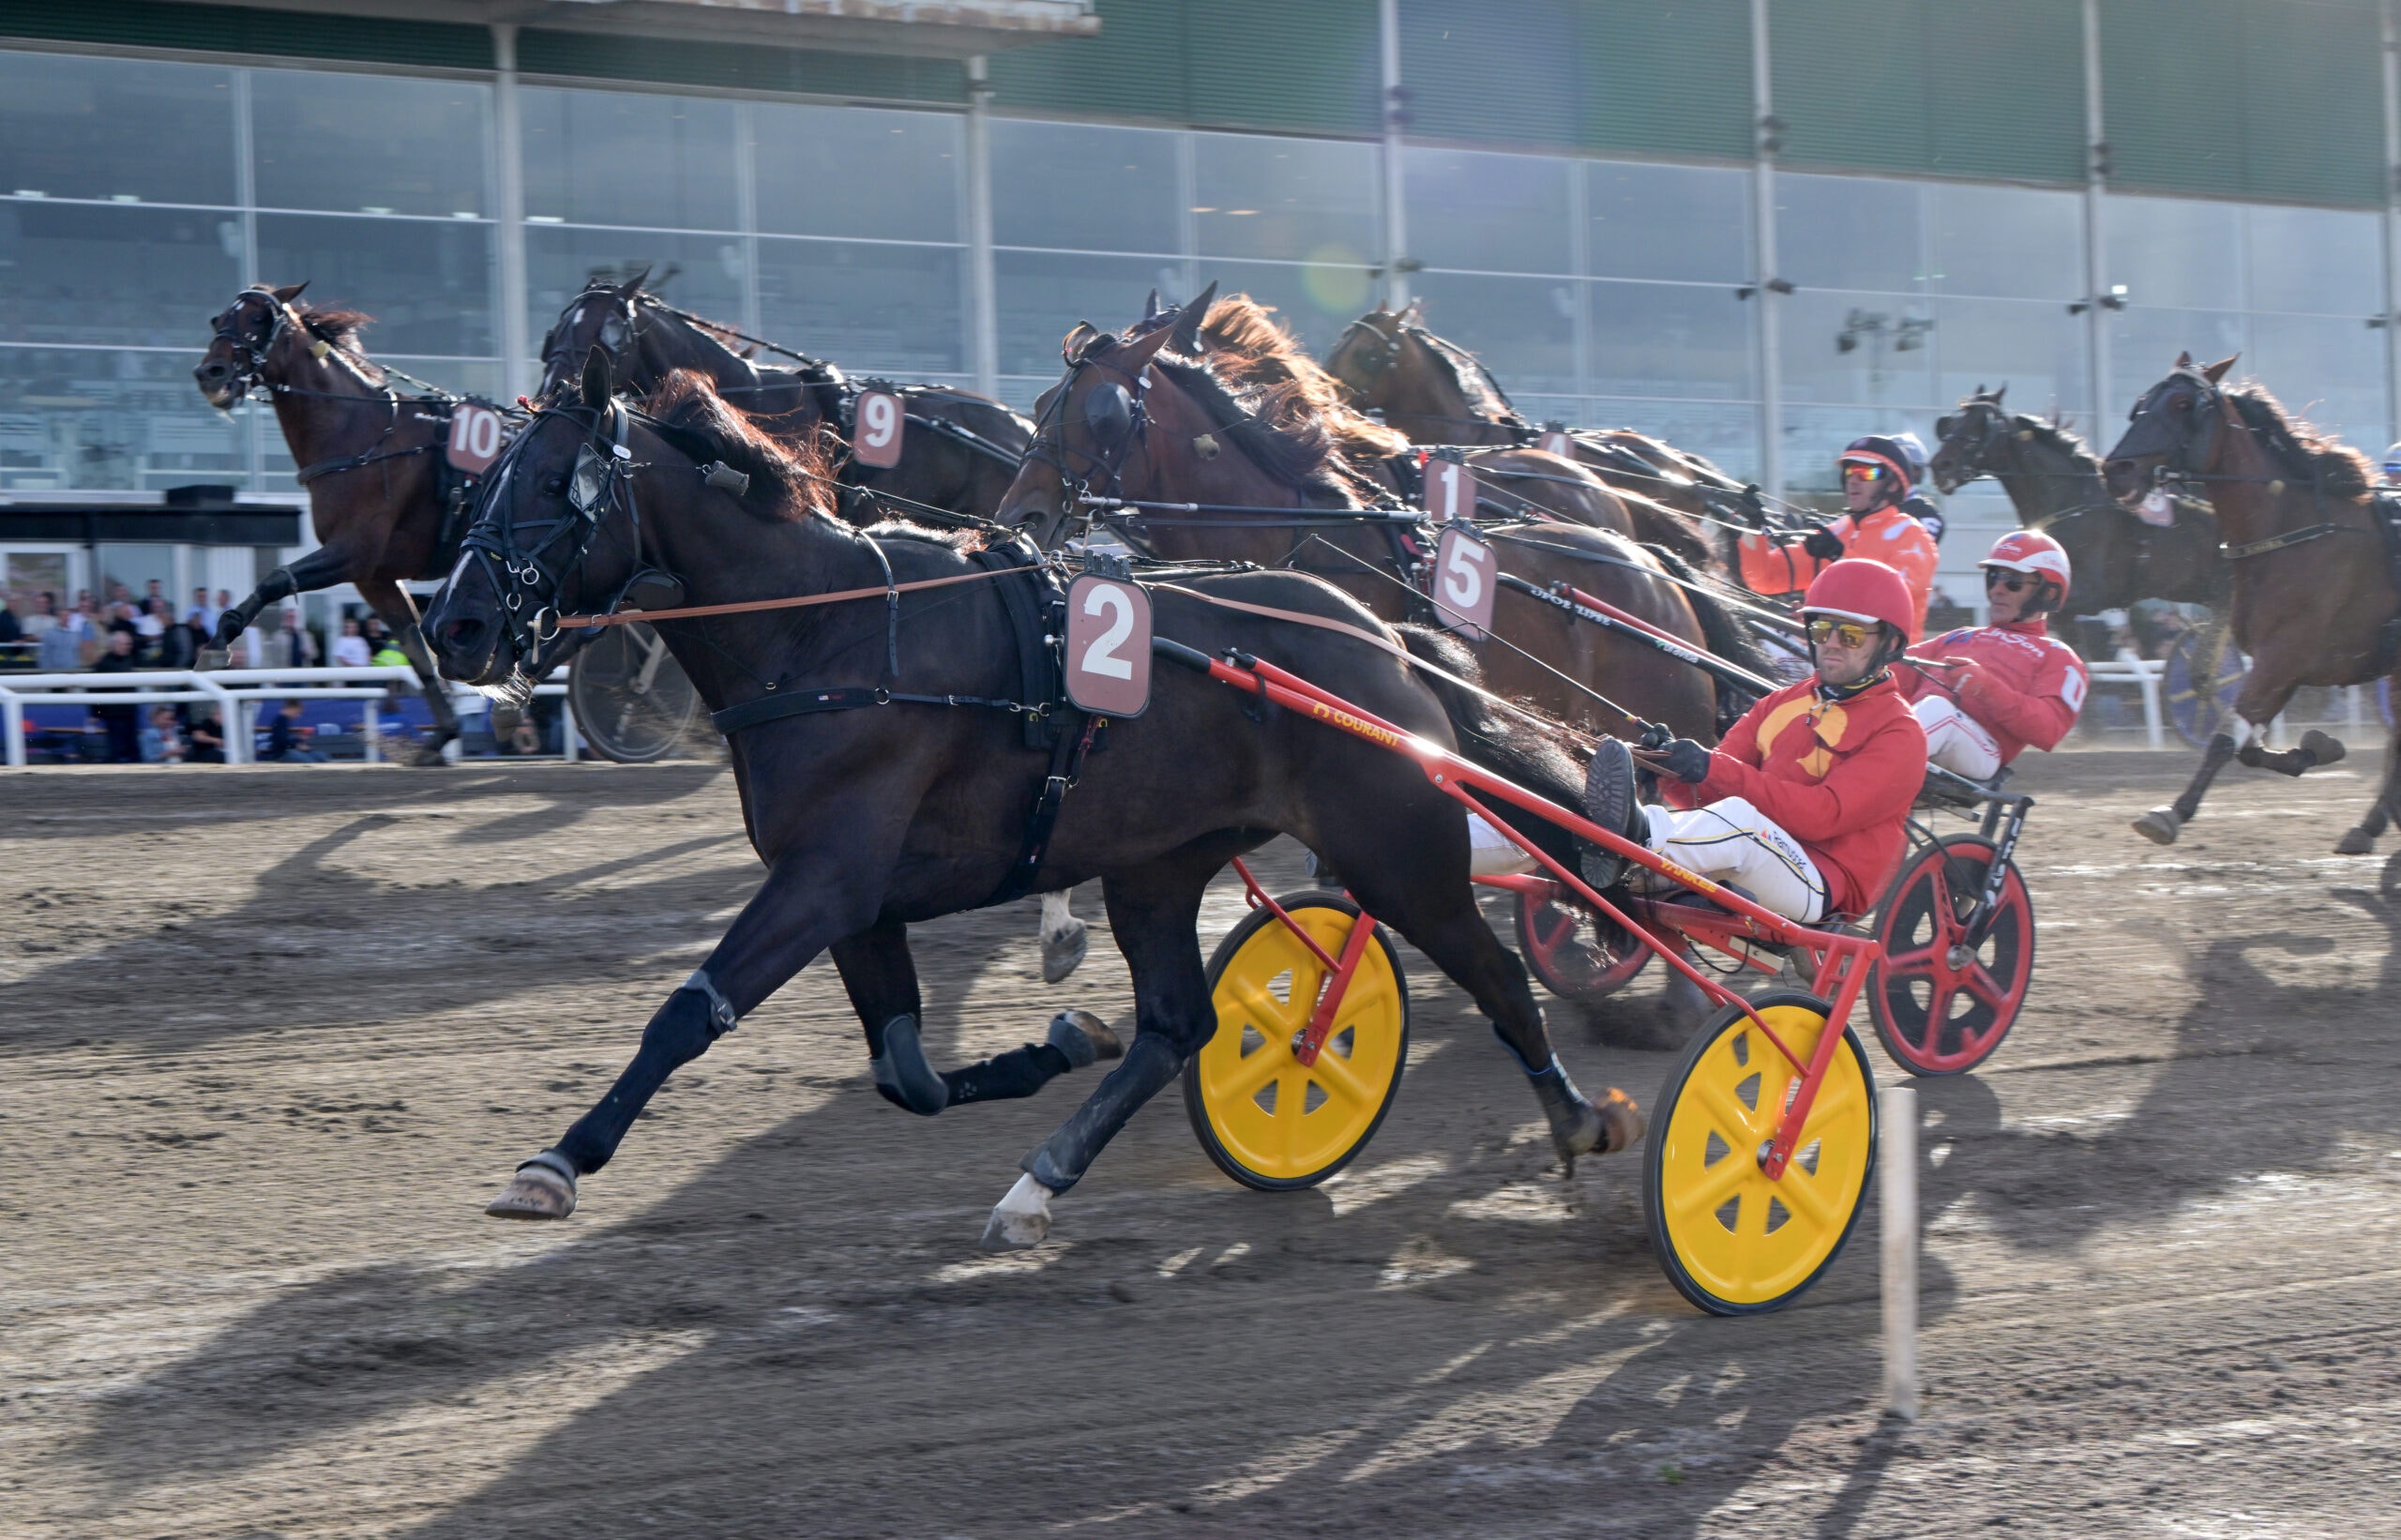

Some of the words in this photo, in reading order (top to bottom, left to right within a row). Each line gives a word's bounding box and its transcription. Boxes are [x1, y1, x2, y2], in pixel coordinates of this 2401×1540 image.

[454, 407, 502, 459] 10
[865, 395, 896, 447] 9
[1441, 463, 1459, 521] 1
[1444, 535, 1486, 608] 5
[1081, 583, 1135, 680] 2
[1334, 712, 1399, 747] COURANT
[1659, 859, 1718, 893] YANKEE
